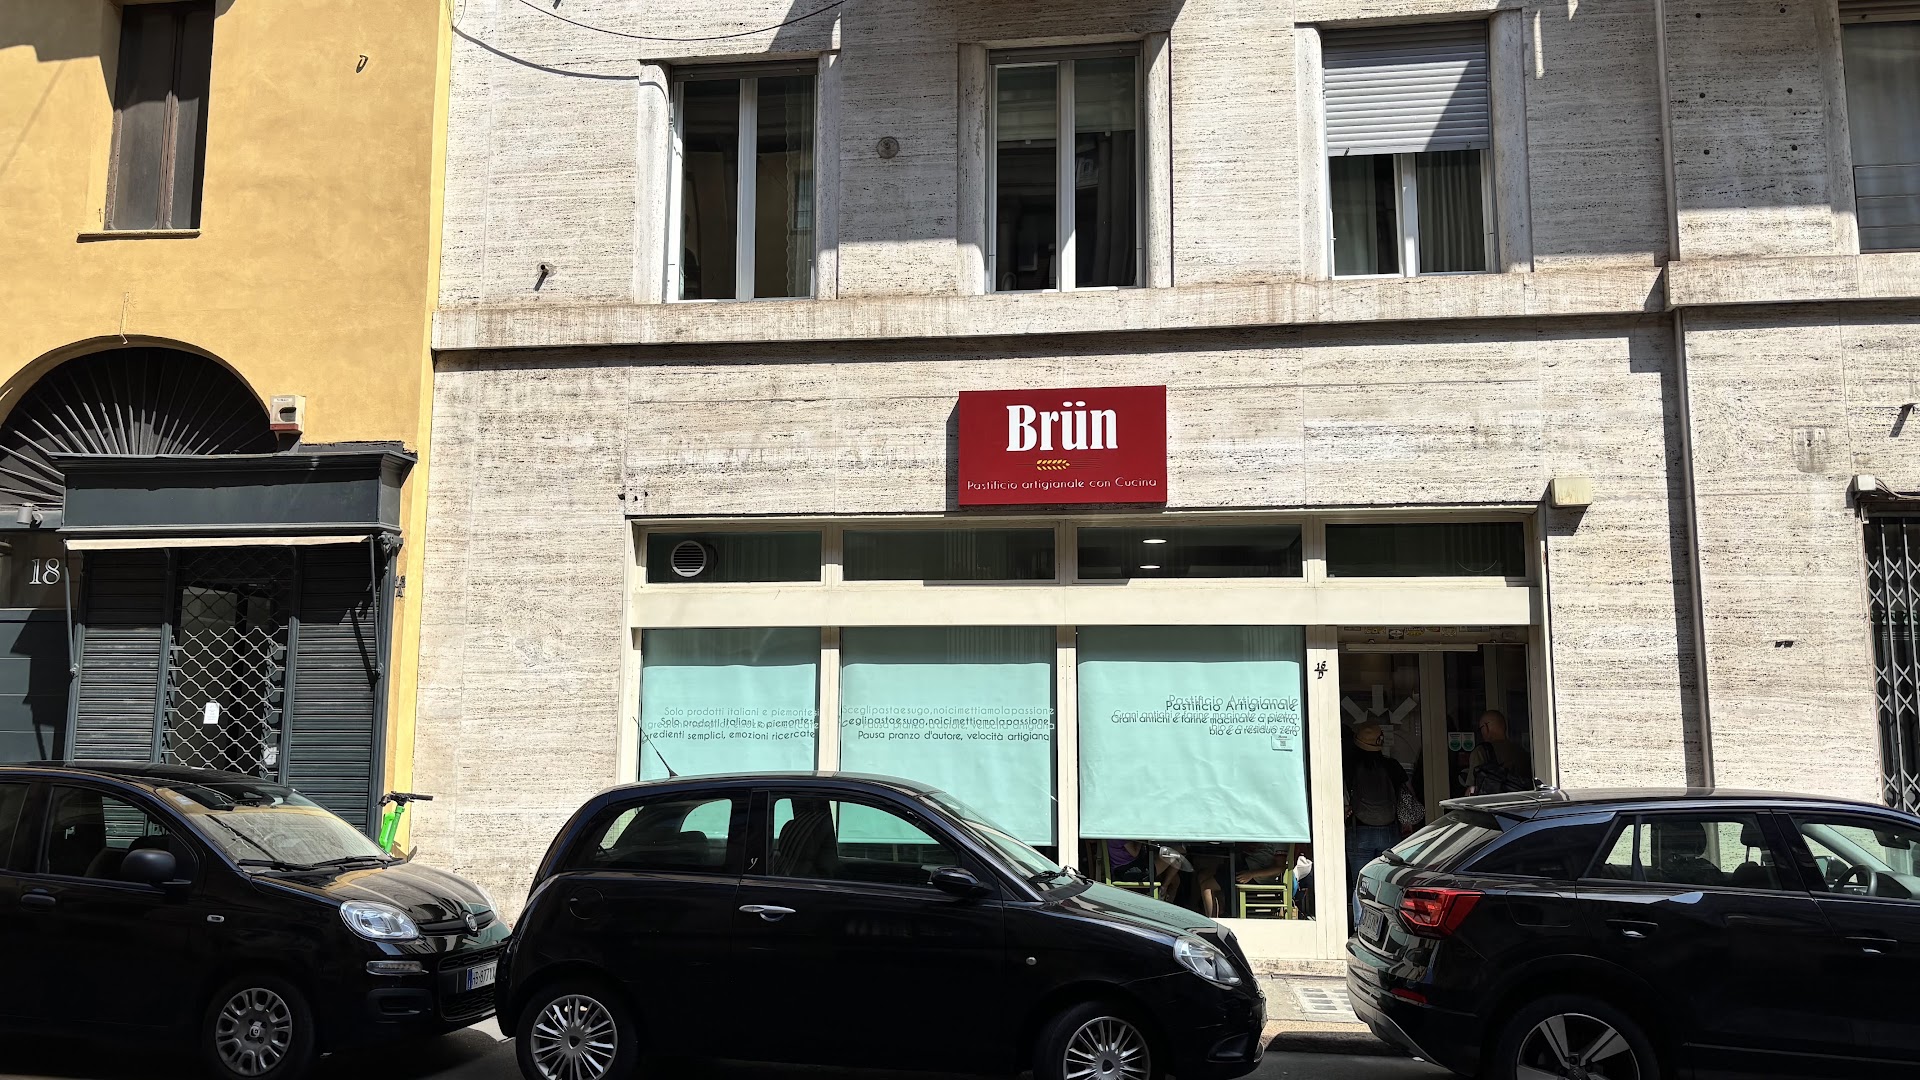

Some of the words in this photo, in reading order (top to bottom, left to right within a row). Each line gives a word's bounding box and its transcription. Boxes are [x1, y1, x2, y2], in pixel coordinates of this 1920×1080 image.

[1006, 401, 1118, 452] Brün
[967, 480, 1018, 491] Pastificio
[1021, 478, 1085, 491] artigianale
[1089, 480, 1111, 488] con
[1115, 476, 1157, 488] Cucina
[29, 558, 61, 585] 18
[858, 730, 885, 740] Pausa
[888, 731, 921, 741] pranzo
[966, 730, 1004, 741] velocità
